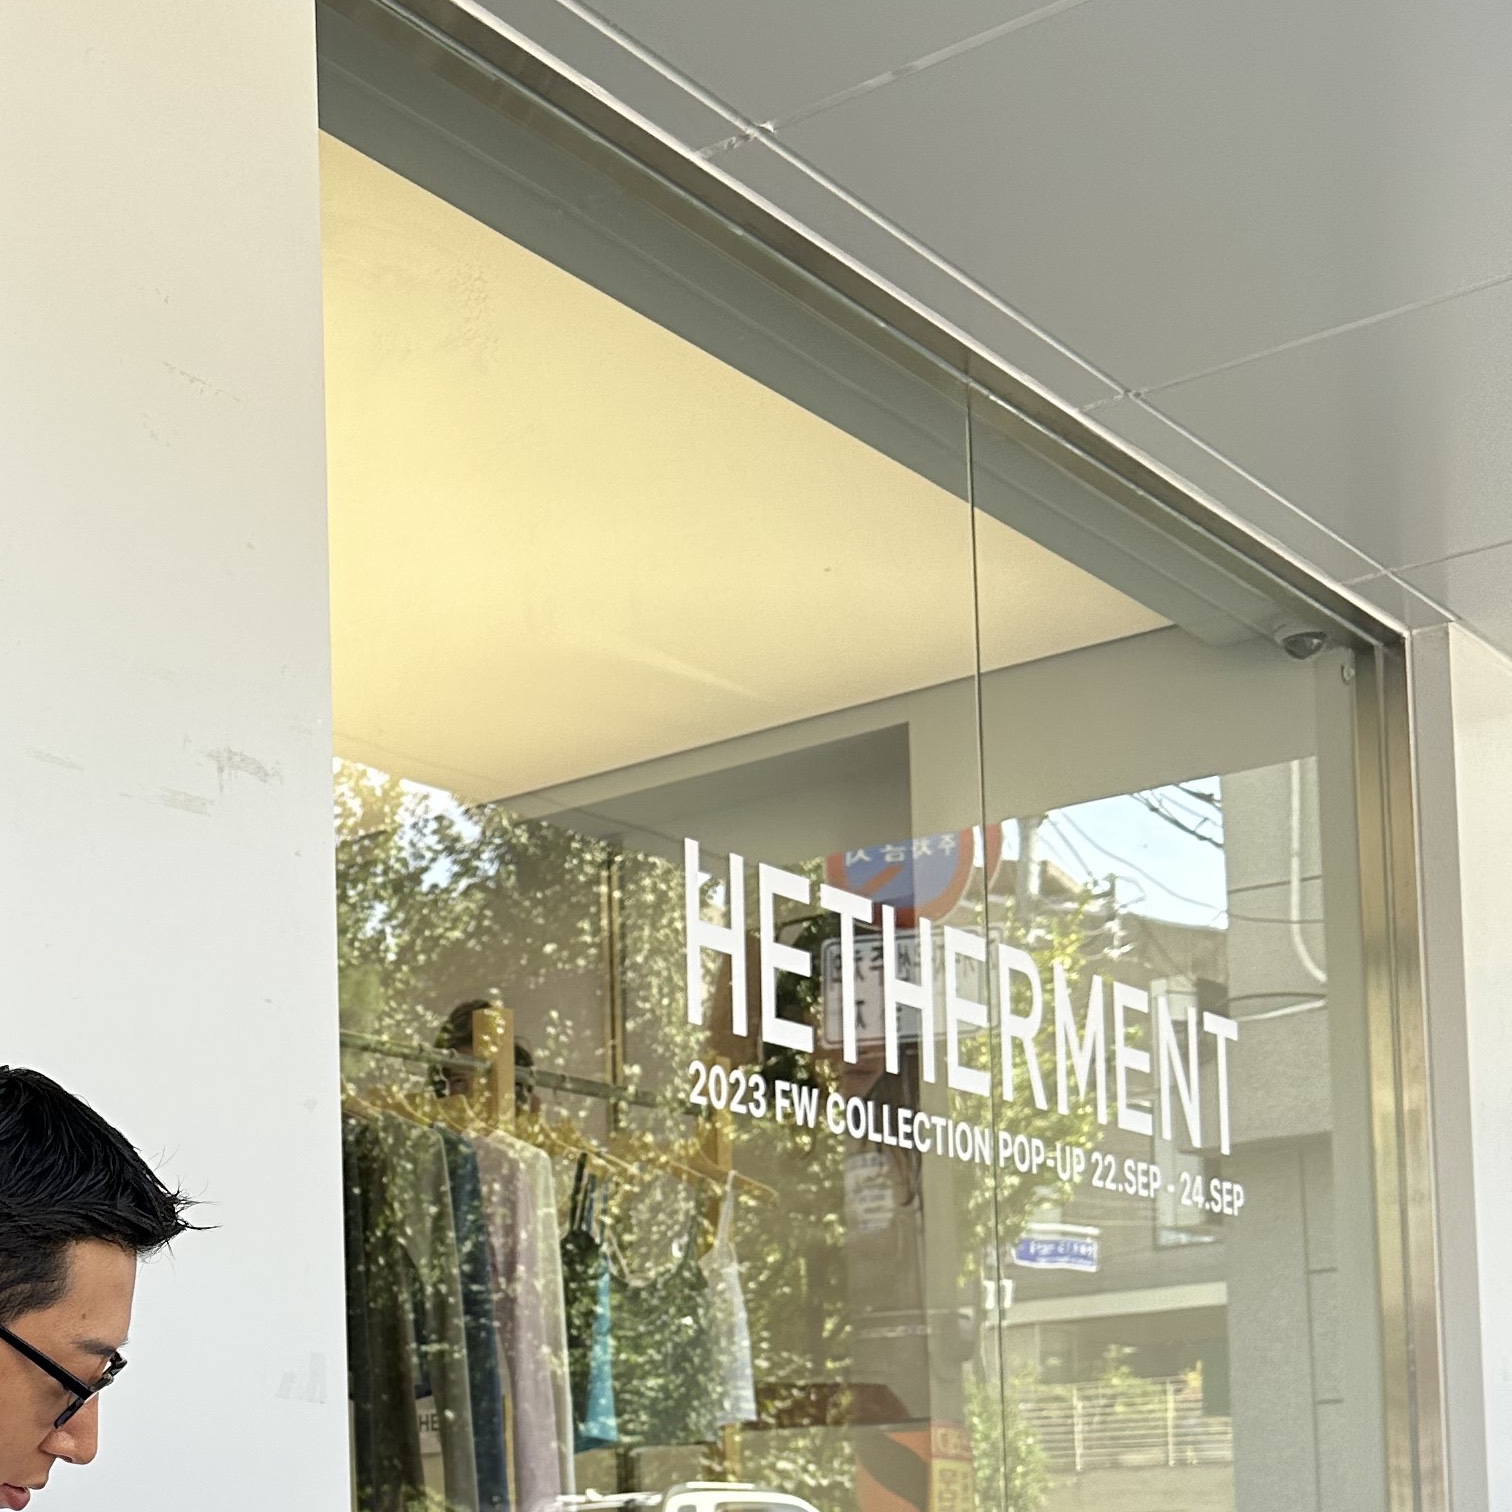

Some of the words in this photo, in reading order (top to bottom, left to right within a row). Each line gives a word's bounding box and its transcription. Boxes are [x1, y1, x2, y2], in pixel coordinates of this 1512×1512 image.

[684, 838, 1239, 1156] HETHERMENT
[690, 1062, 766, 1119] 2023
[774, 1081, 819, 1129] FW
[826, 1092, 991, 1166] COLLECTION
[998, 1131, 1085, 1181] POP-UP
[1090, 1151, 1161, 1197] 22.SEP
[1179, 1172, 1245, 1216] 24.SEP
